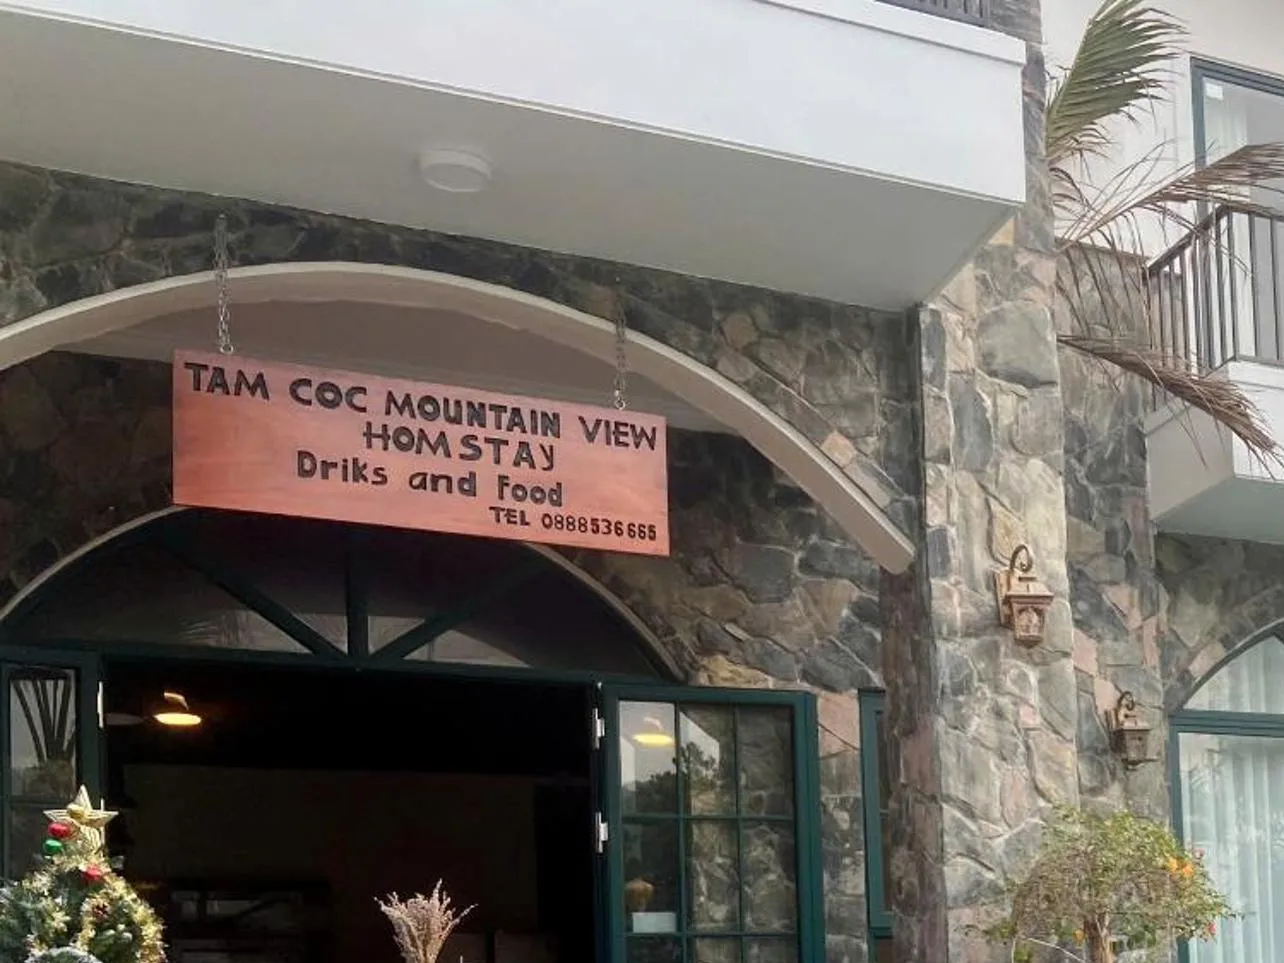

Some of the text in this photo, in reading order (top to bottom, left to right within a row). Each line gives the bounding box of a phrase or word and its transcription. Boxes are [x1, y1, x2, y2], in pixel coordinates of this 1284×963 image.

[184, 362, 657, 451] TAM COC MOUNTAIN VIEW
[297, 450, 388, 485] Driks
[408, 471, 477, 497] and
[489, 506, 531, 526] TEL
